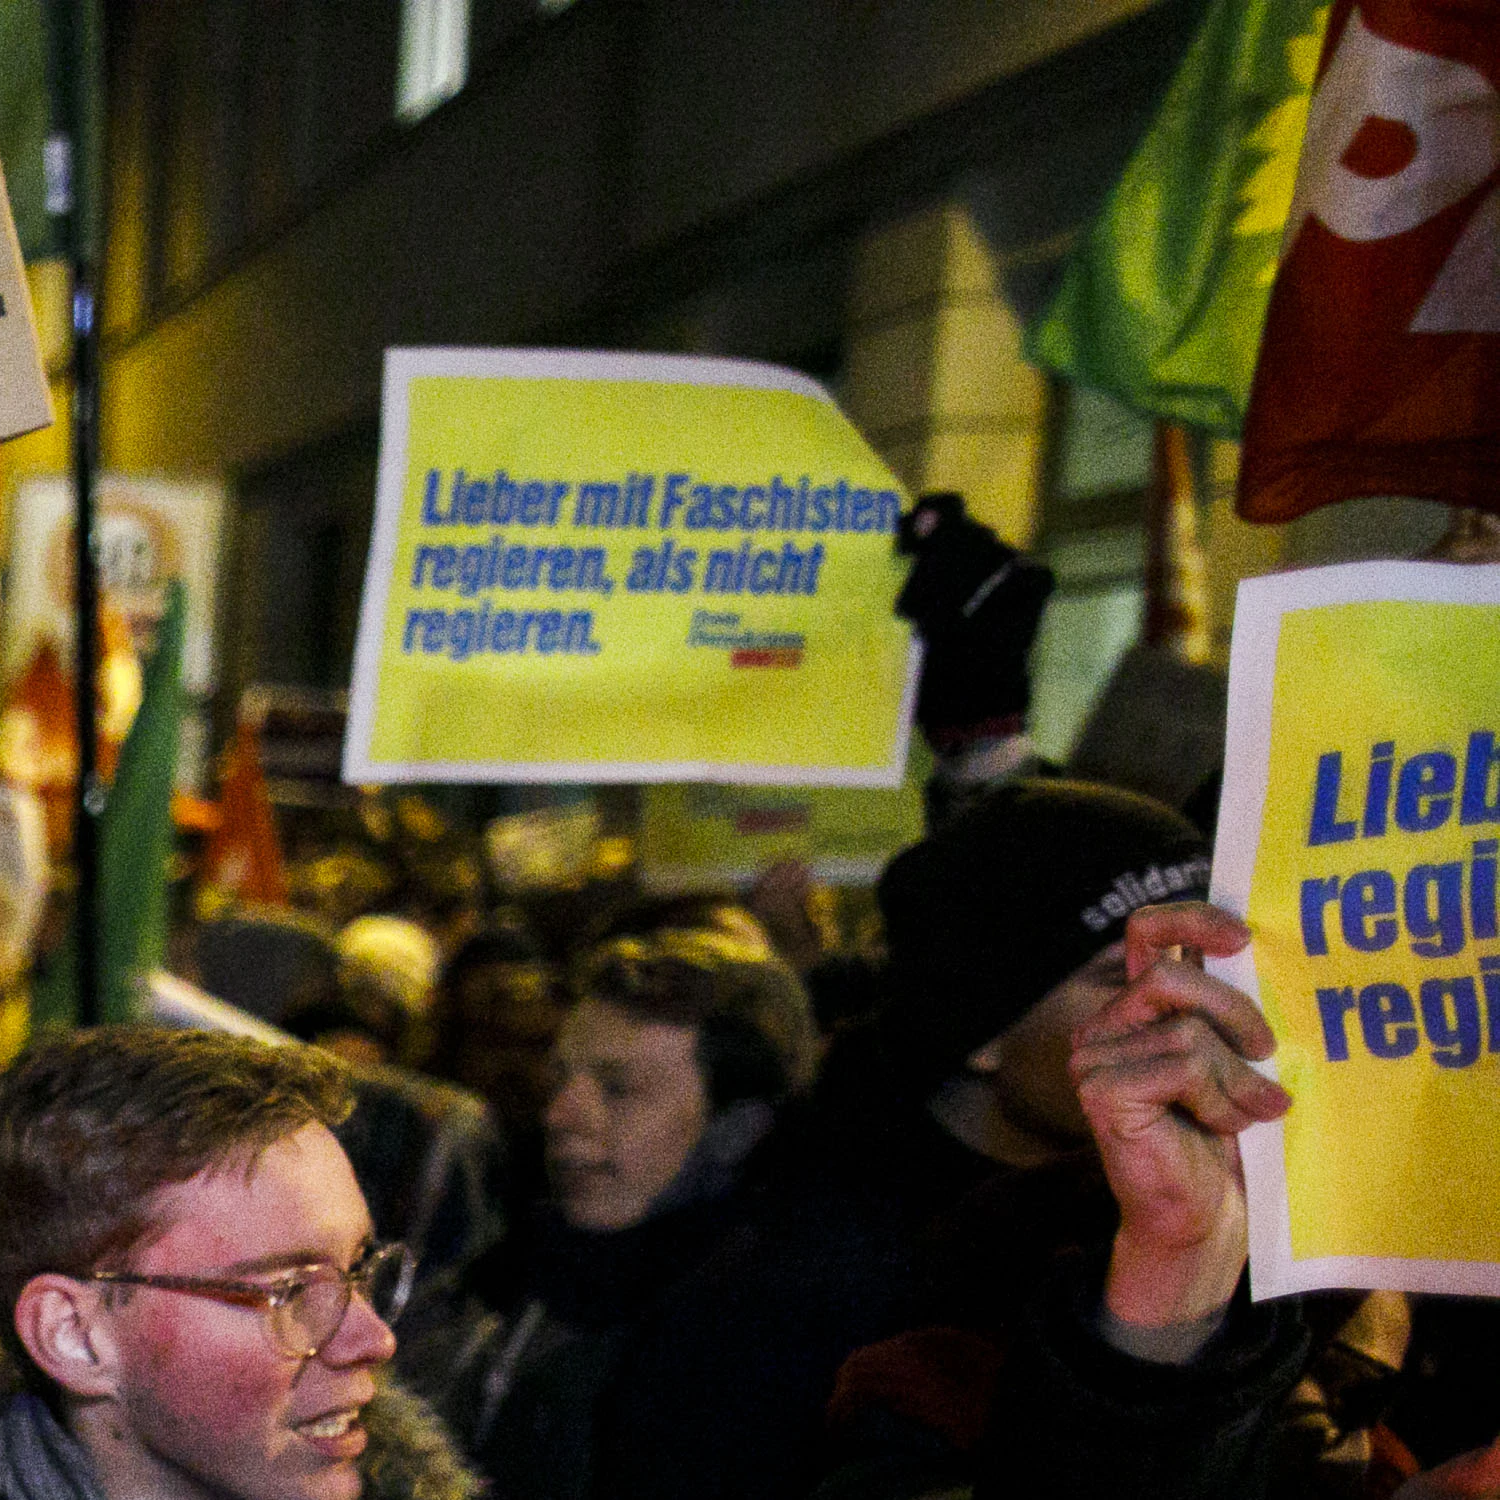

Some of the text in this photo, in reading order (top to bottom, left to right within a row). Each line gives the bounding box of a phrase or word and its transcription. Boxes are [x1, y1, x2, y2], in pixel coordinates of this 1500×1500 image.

[421, 468, 901, 535] Lieber mit Faschisten
[626, 540, 697, 594] als
[705, 540, 825, 596] nicht
